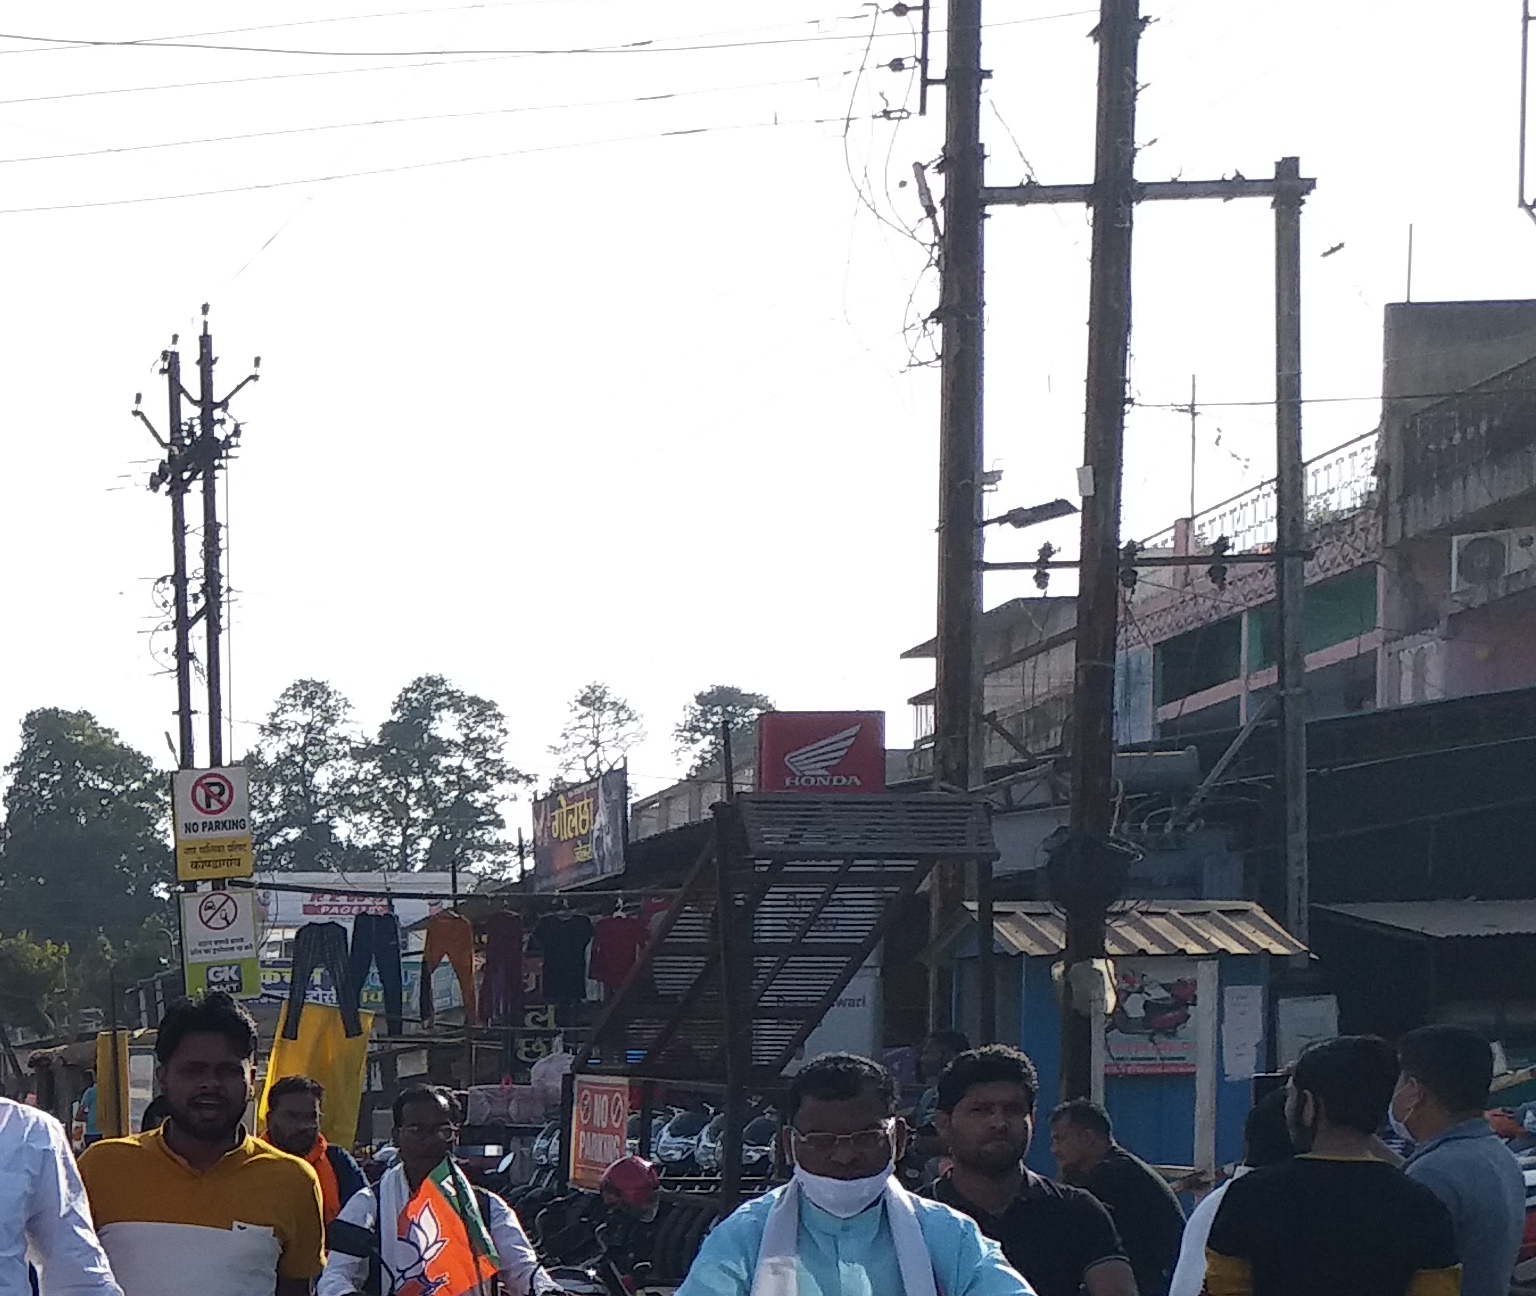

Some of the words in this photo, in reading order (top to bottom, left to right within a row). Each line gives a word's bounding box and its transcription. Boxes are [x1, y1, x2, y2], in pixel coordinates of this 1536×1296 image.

[785, 775, 862, 787] HONDA
[184, 821, 199, 834] NO
[201, 818, 246, 833] PARKING
[208, 966, 240, 982] GK
[593, 1093, 608, 1128] NO
[579, 1130, 620, 1164] PARKING
